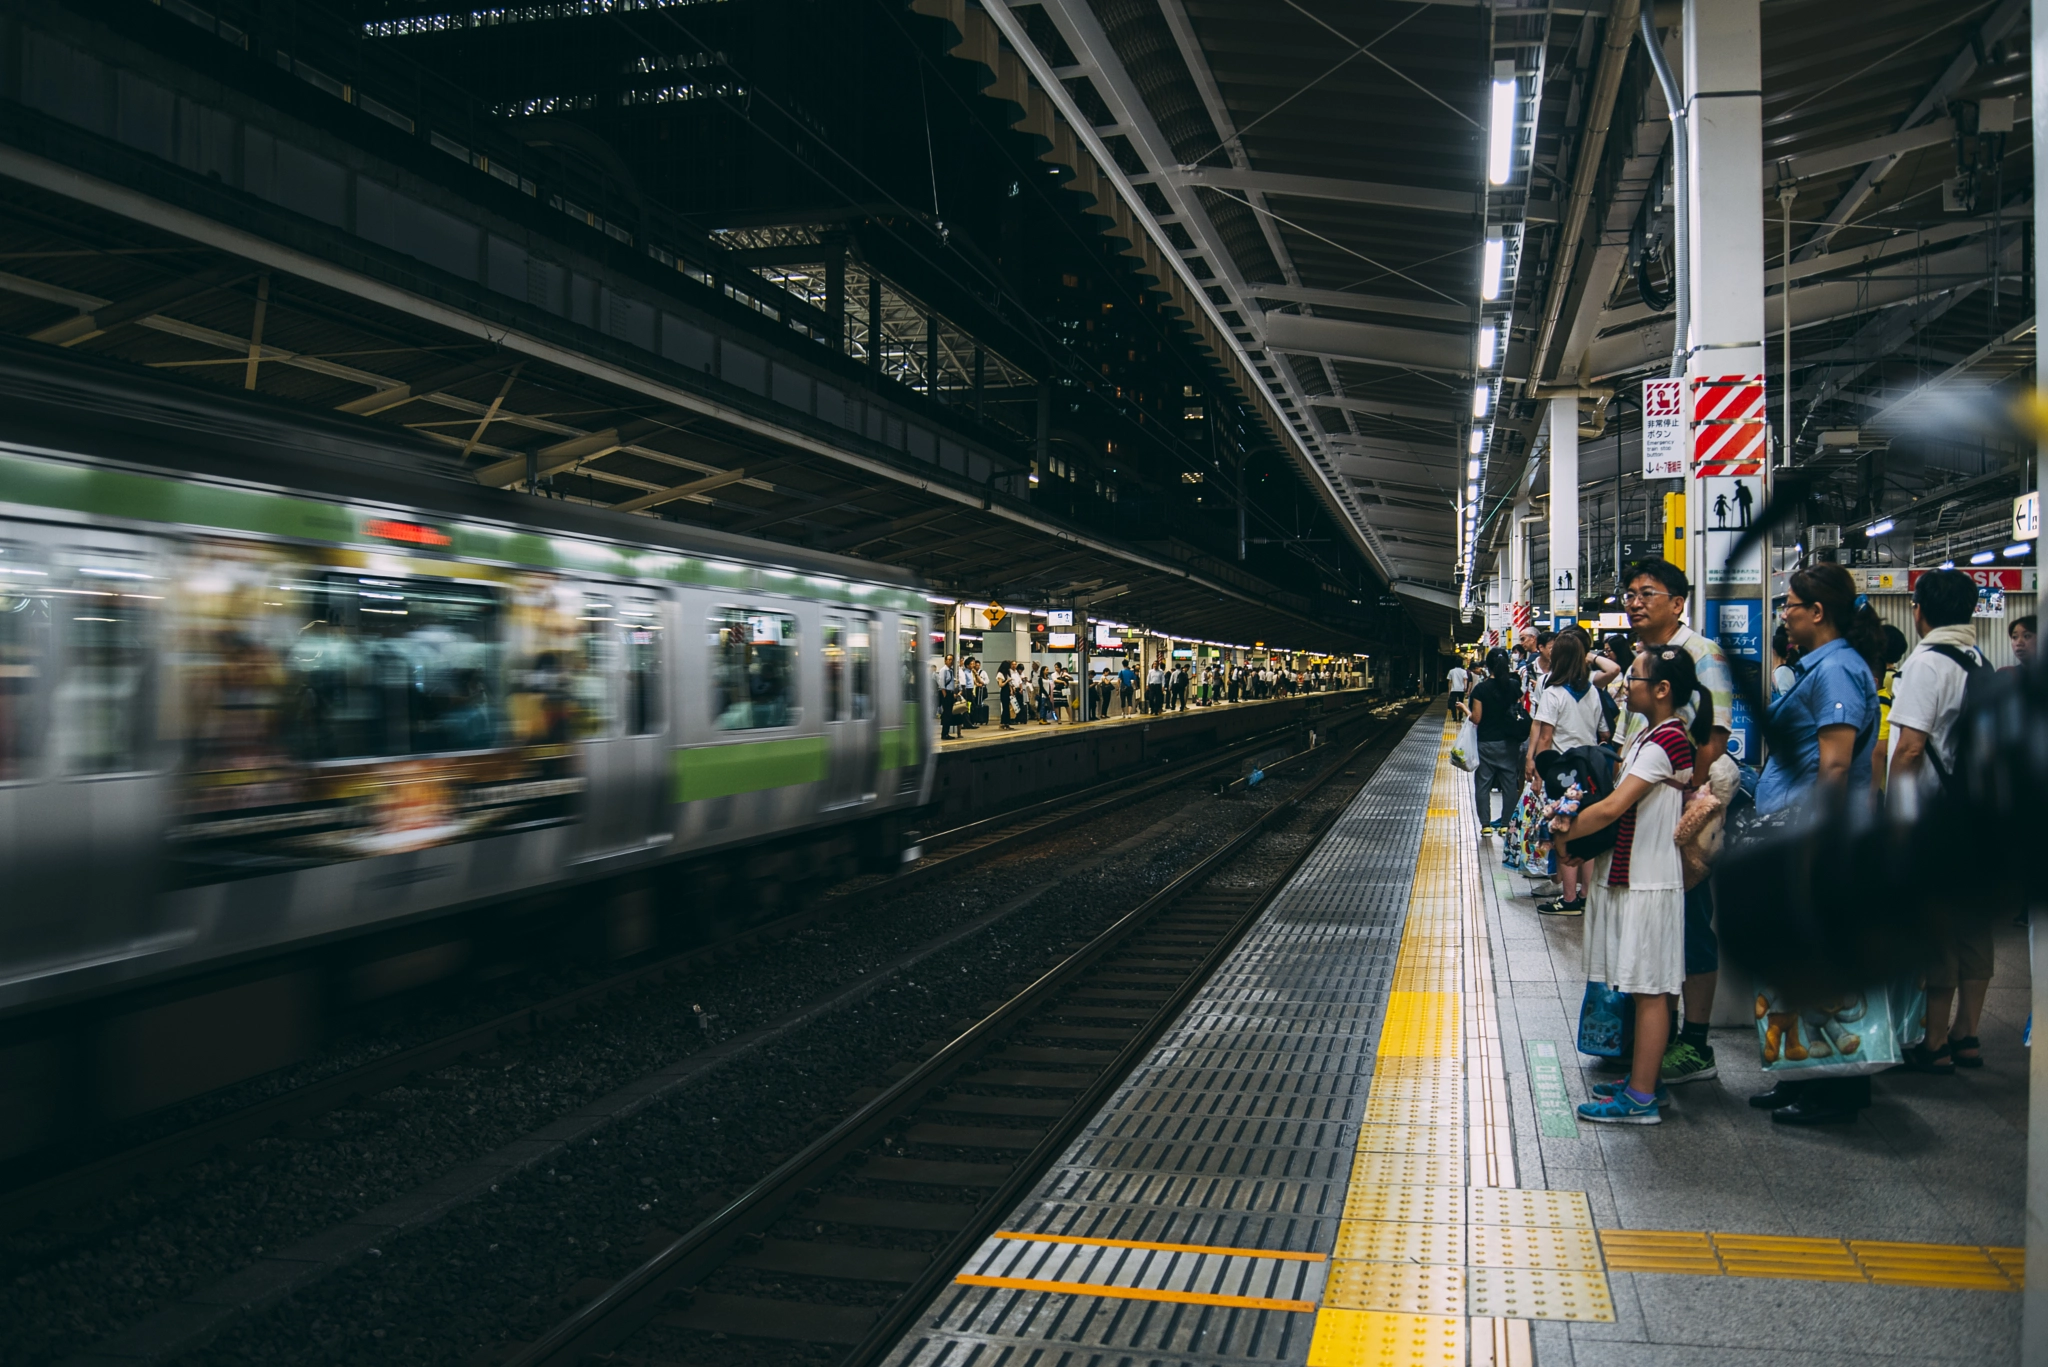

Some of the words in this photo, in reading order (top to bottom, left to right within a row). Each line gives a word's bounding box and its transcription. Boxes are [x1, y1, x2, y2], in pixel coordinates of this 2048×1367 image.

[1647, 418, 1680, 429] 非常停止
[1647, 430, 1672, 439] ボタン
[1624, 544, 1632, 555] 5
[1532, 606, 1540, 618] 5
[1722, 620, 1746, 628] STAY
